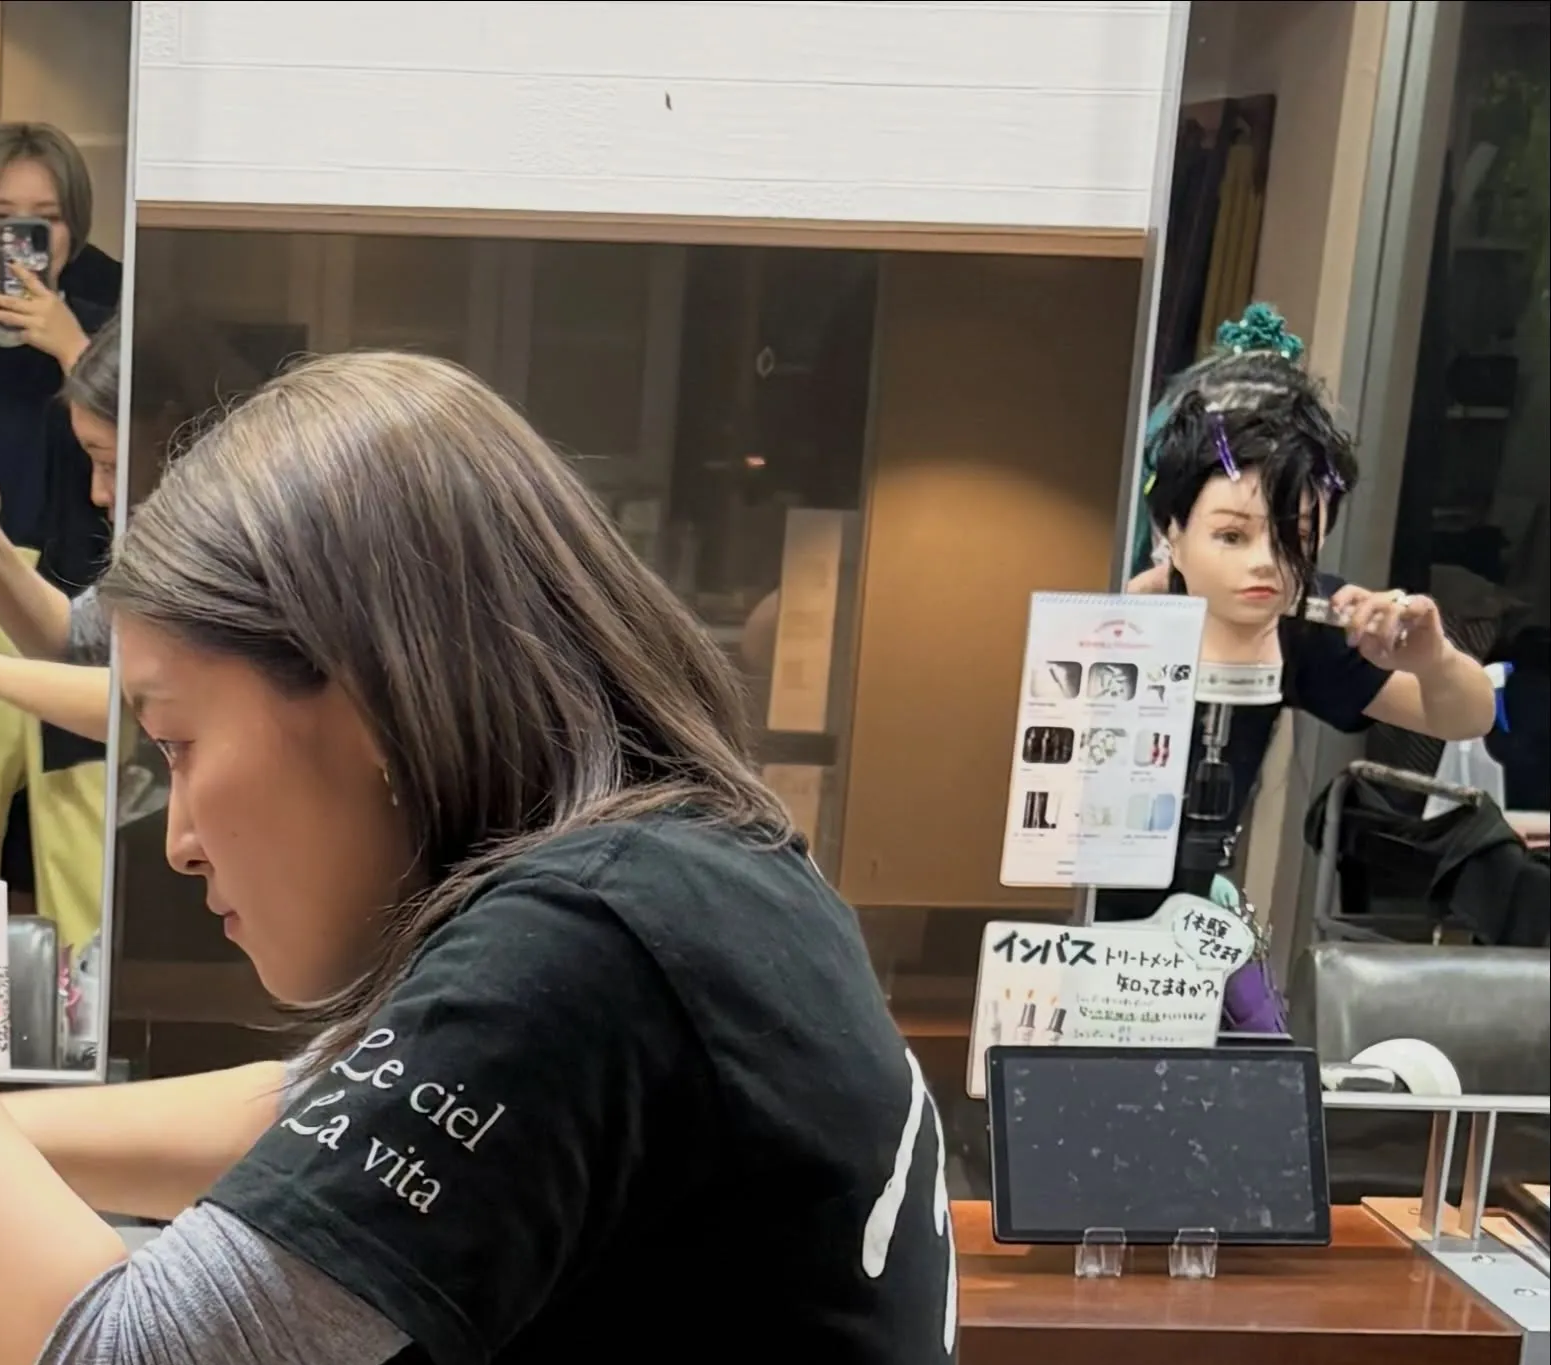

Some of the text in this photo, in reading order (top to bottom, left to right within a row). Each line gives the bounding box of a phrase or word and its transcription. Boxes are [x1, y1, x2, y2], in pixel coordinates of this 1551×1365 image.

[1183, 908, 1233, 939] 体験
[993, 930, 1184, 969] インバス トリートメント
[1199, 938, 1242, 965] できます
[330, 1028, 506, 1152] Le ciel
[280, 1089, 441, 1214] La vita
